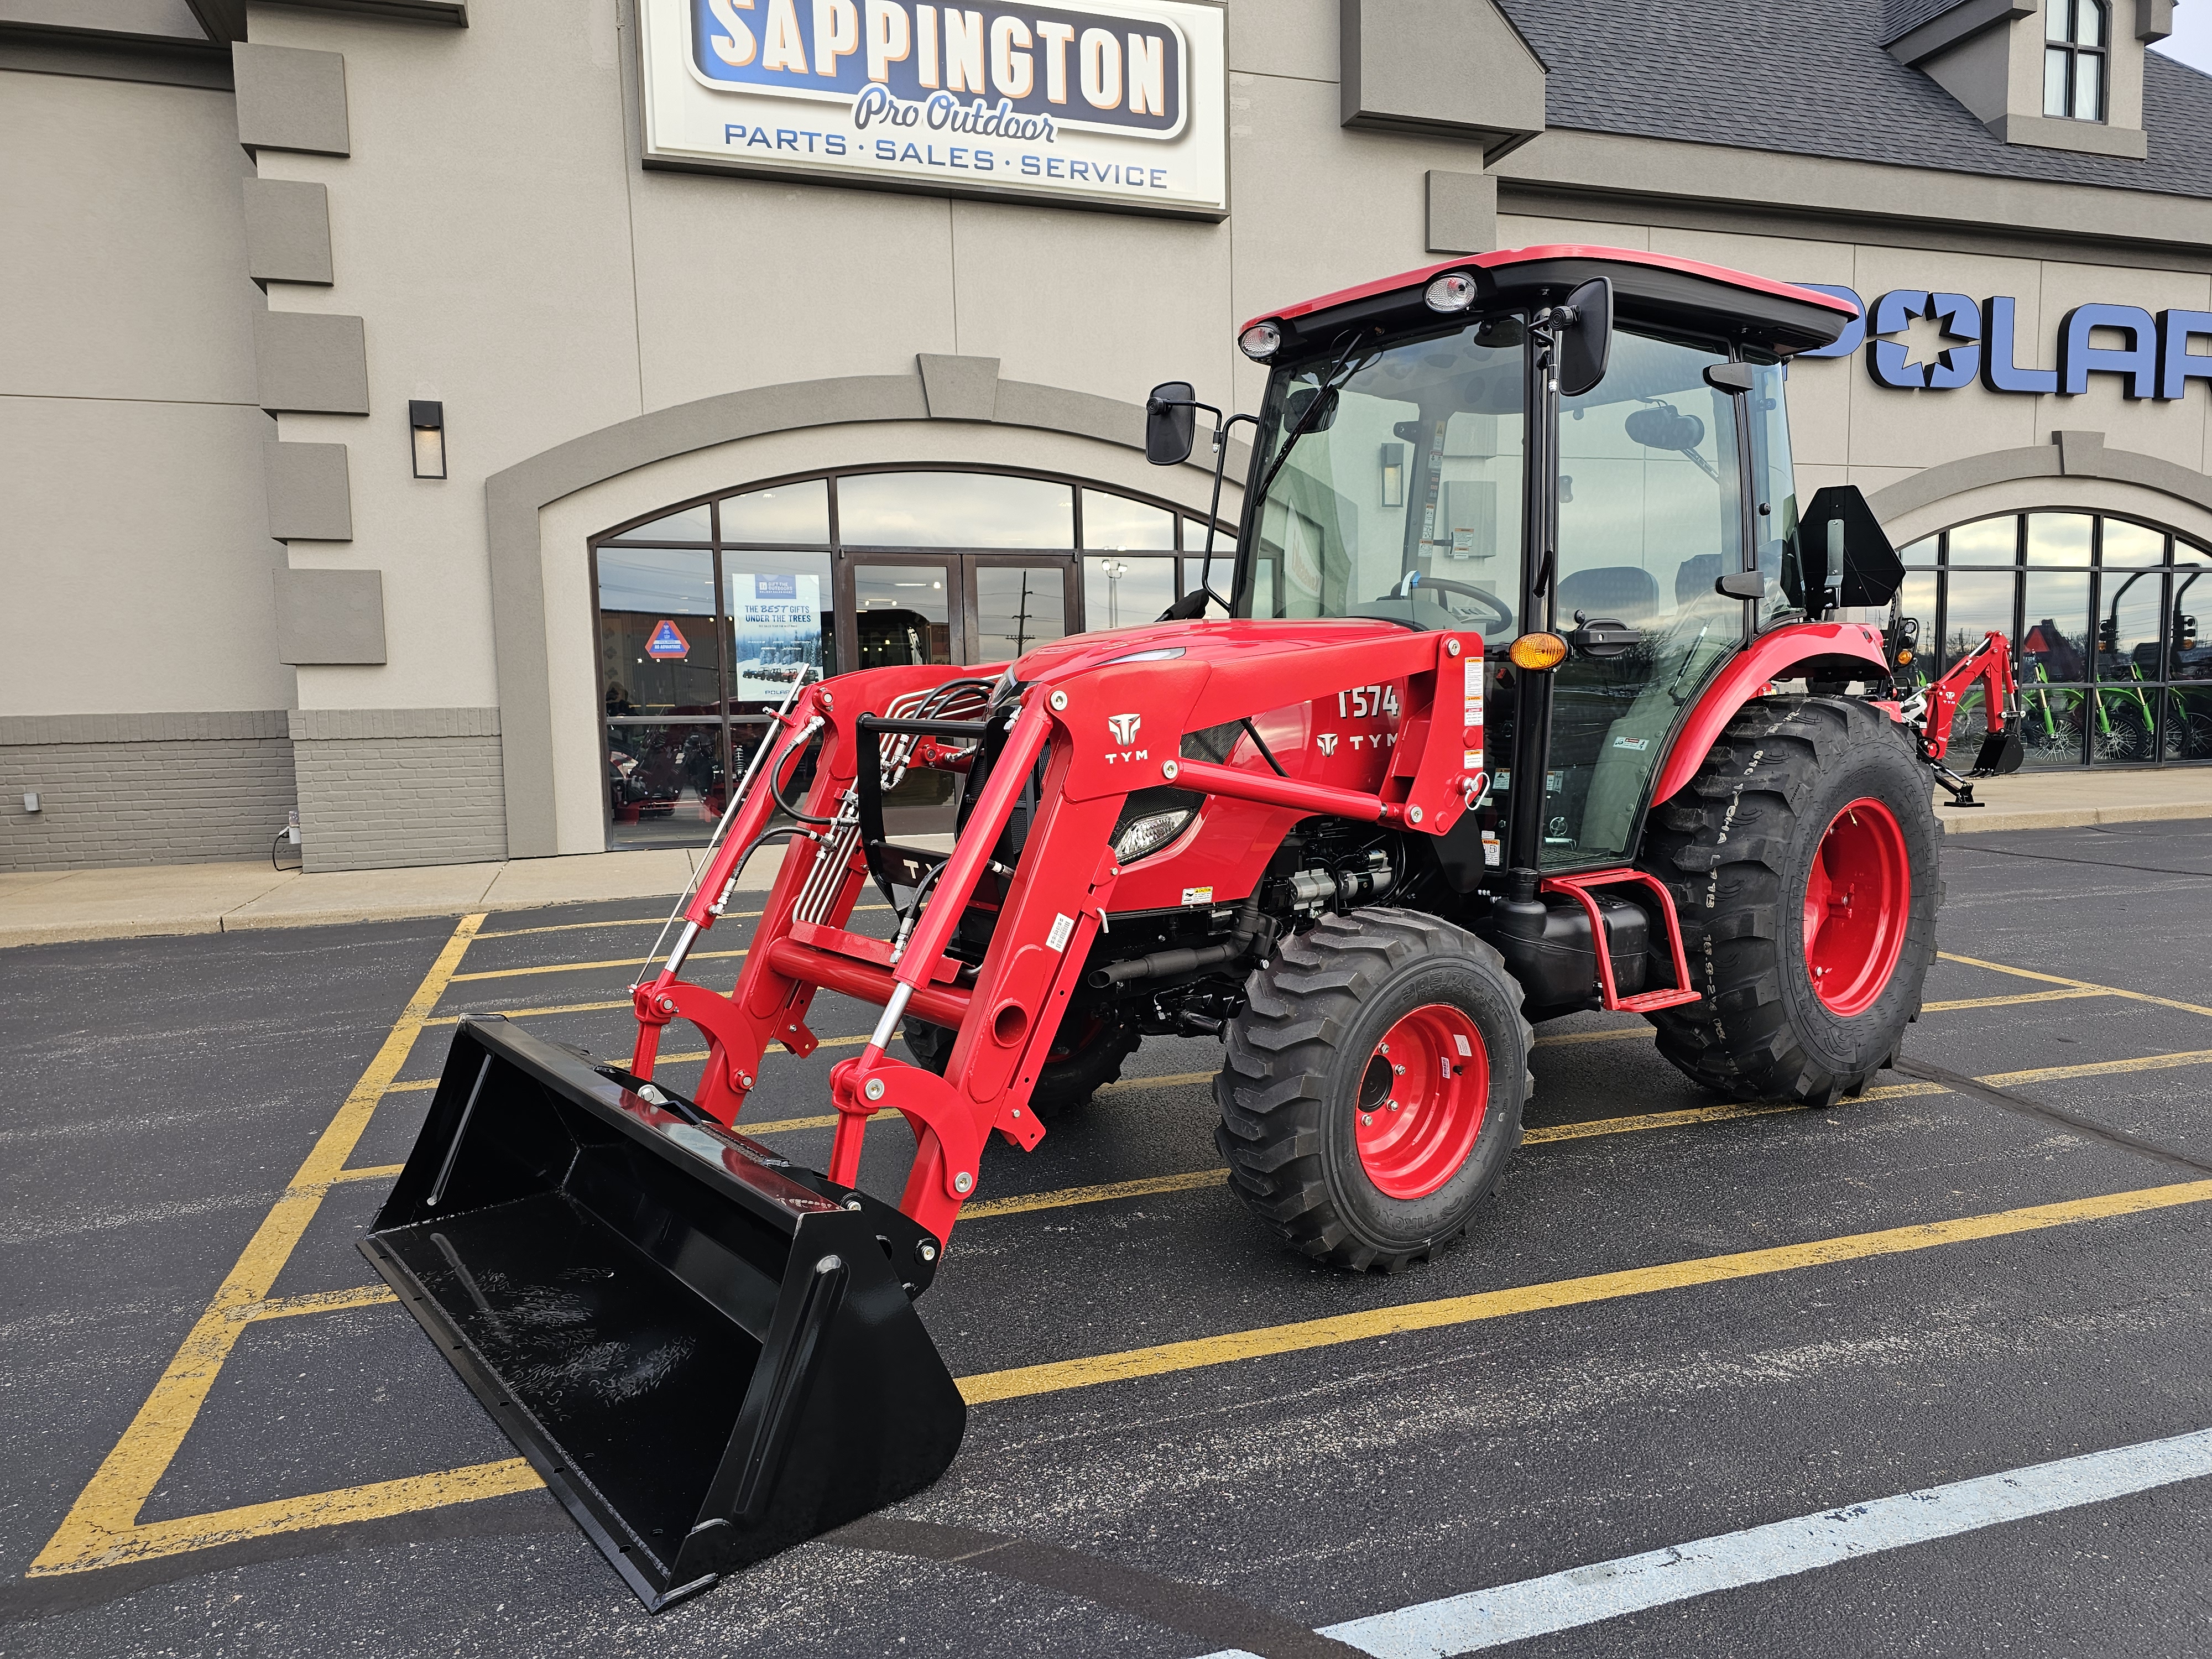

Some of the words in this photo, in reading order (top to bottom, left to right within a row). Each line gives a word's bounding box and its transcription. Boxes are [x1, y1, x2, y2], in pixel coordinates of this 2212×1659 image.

[708, 0, 1165, 117] SAPPINGTON
[854, 85, 920, 131] Pro
[925, 93, 1056, 144] Outdoor
[724, 123, 848, 156] PARTS
[875, 140, 994, 171] SALES
[1020, 156, 1168, 189] SERVICE
[760, 605, 789, 613] BEST
[1338, 685, 1399, 718] T574
[1105, 749, 1148, 764] TYM
[1350, 732, 1398, 750] TYM
